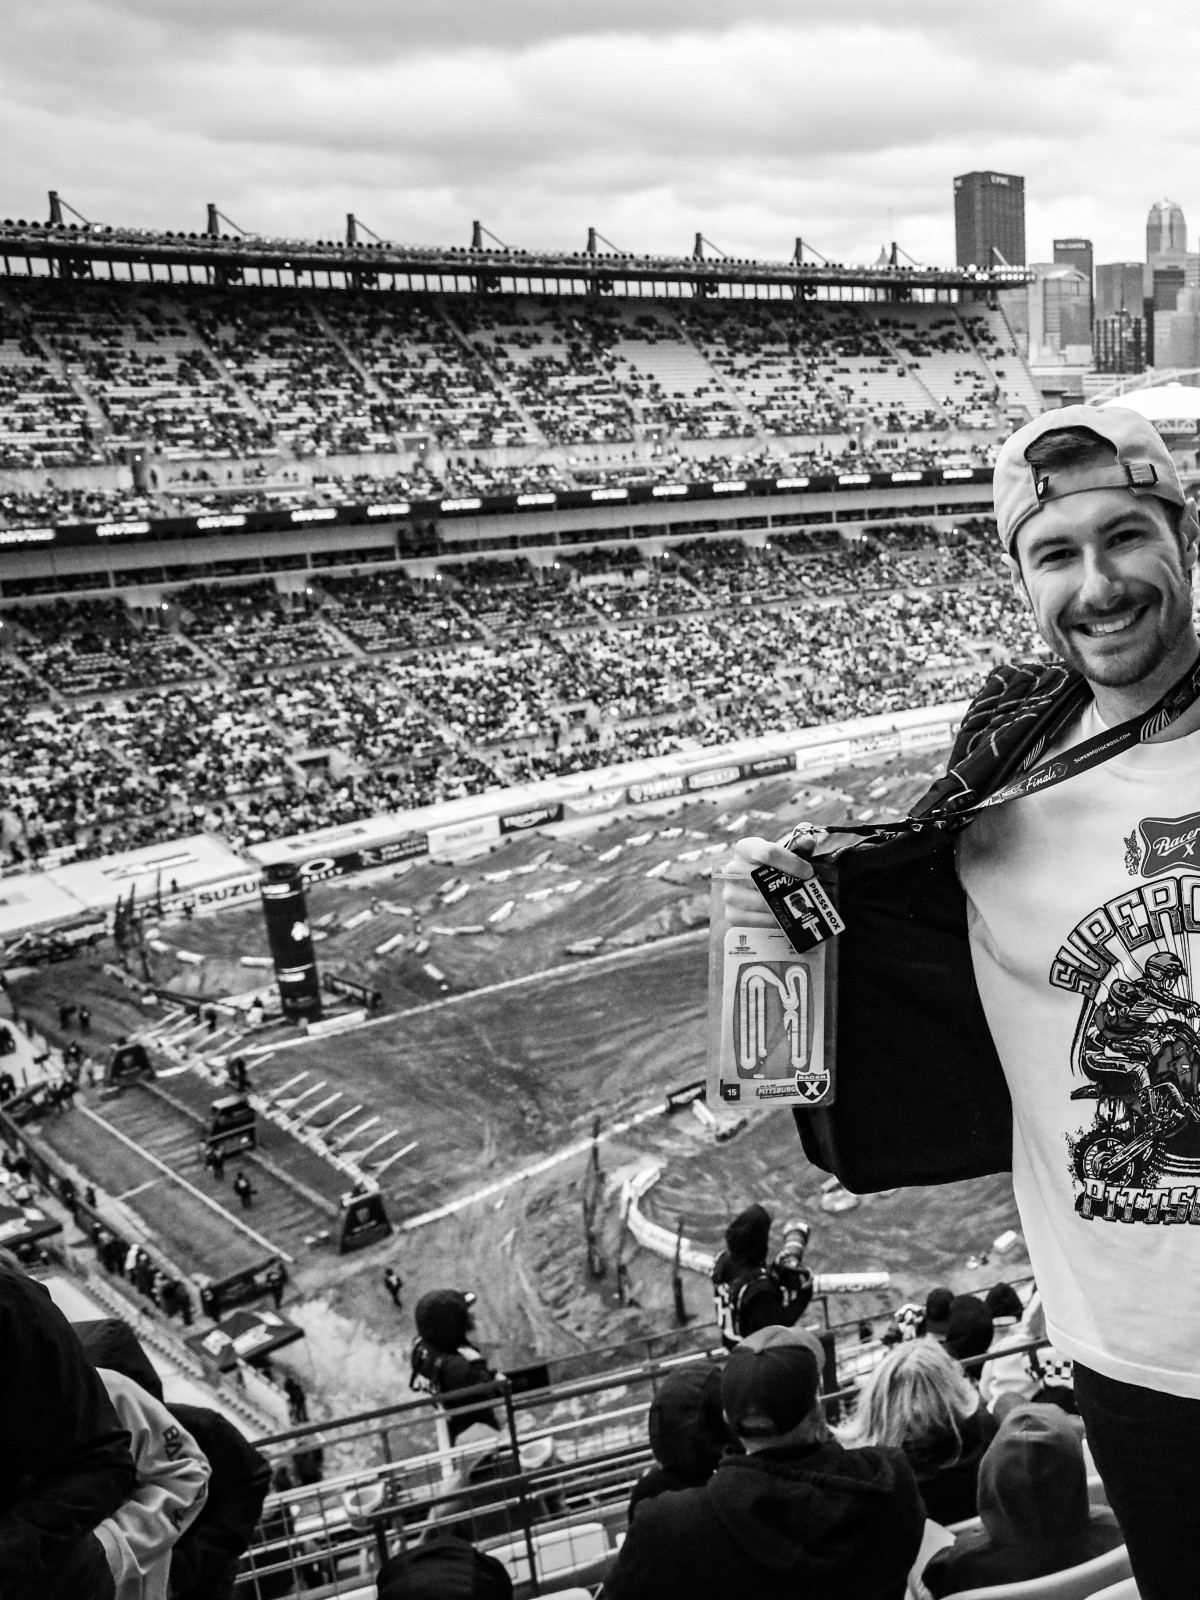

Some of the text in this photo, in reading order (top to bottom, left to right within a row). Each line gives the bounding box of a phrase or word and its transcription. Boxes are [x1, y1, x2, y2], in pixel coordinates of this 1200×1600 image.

[1025, 766, 1057, 792] Finals
[1182, 840, 1197, 858] X
[808, 881, 829, 911] PRESS
[825, 910, 841, 931] BOX
[727, 1085, 797, 1096] 15 PITTSBURG
[804, 1081, 820, 1096] X
